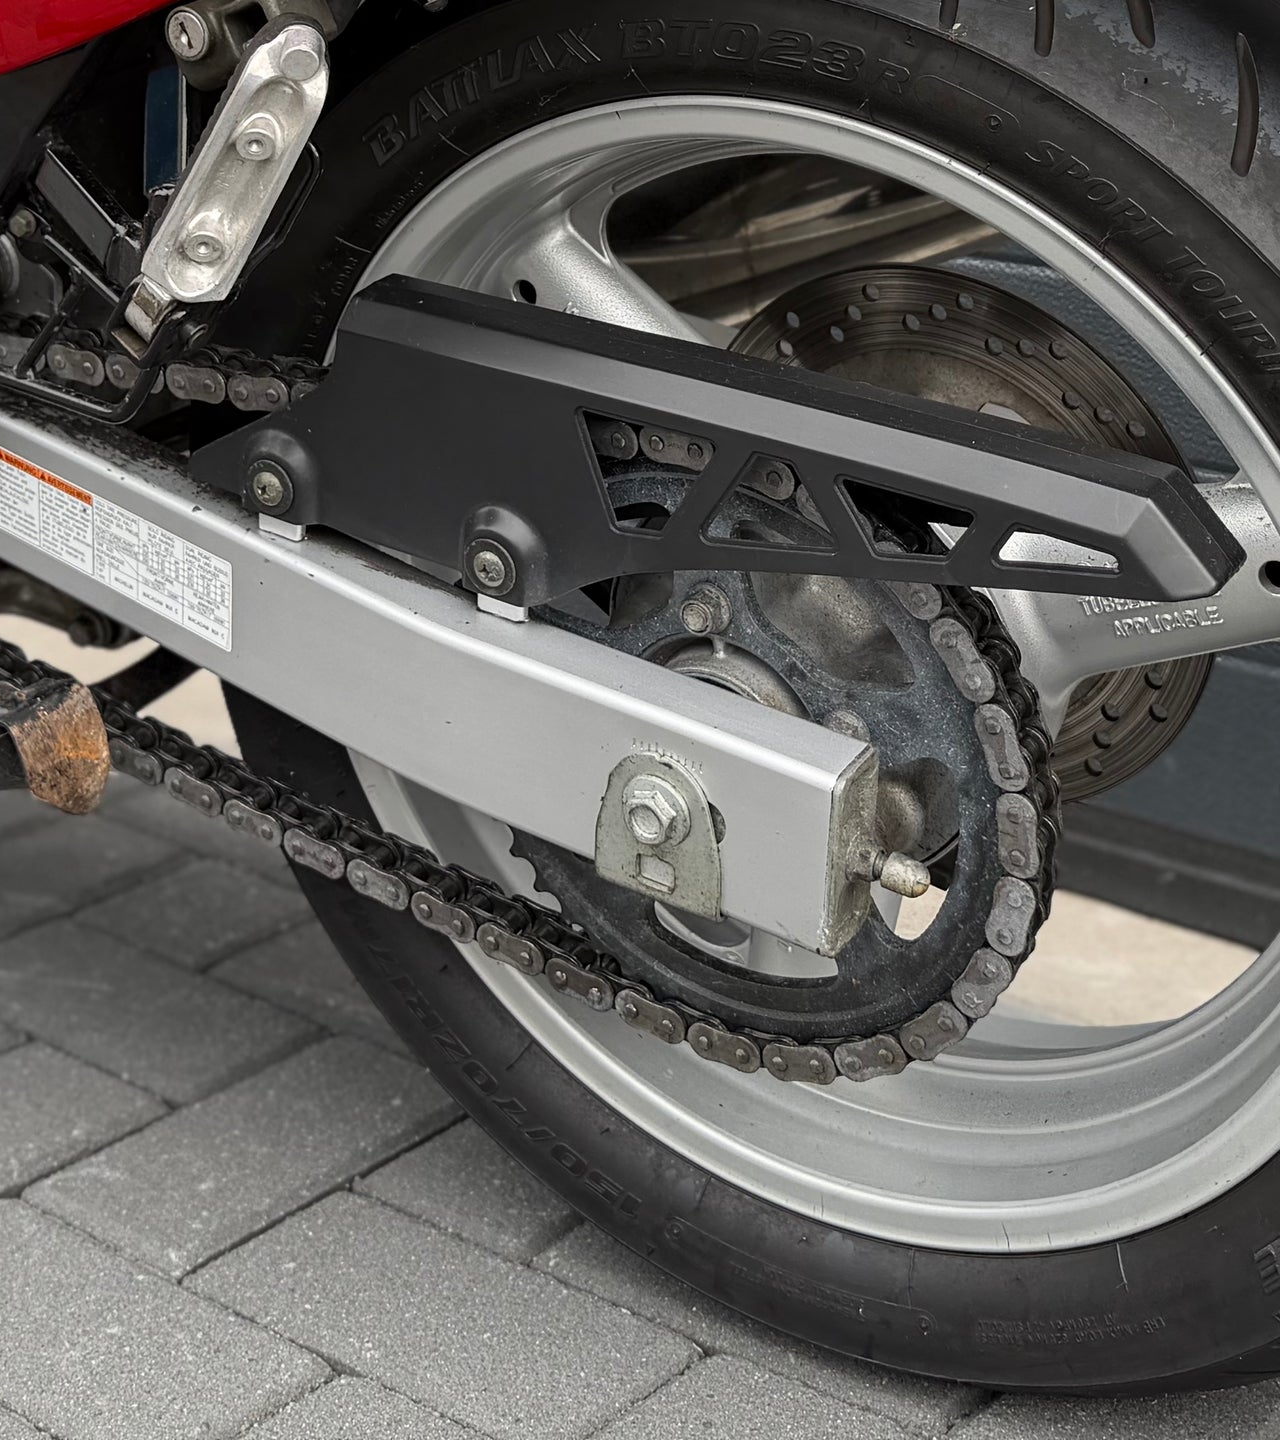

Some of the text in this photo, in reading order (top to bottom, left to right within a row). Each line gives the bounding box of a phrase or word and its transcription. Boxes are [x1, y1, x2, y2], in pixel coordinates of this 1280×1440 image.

[362, 22, 604, 168] BATTLAX
[1024, 139, 1173, 244] SPORT
[1114, 605, 1224, 638] APPLICABLE
